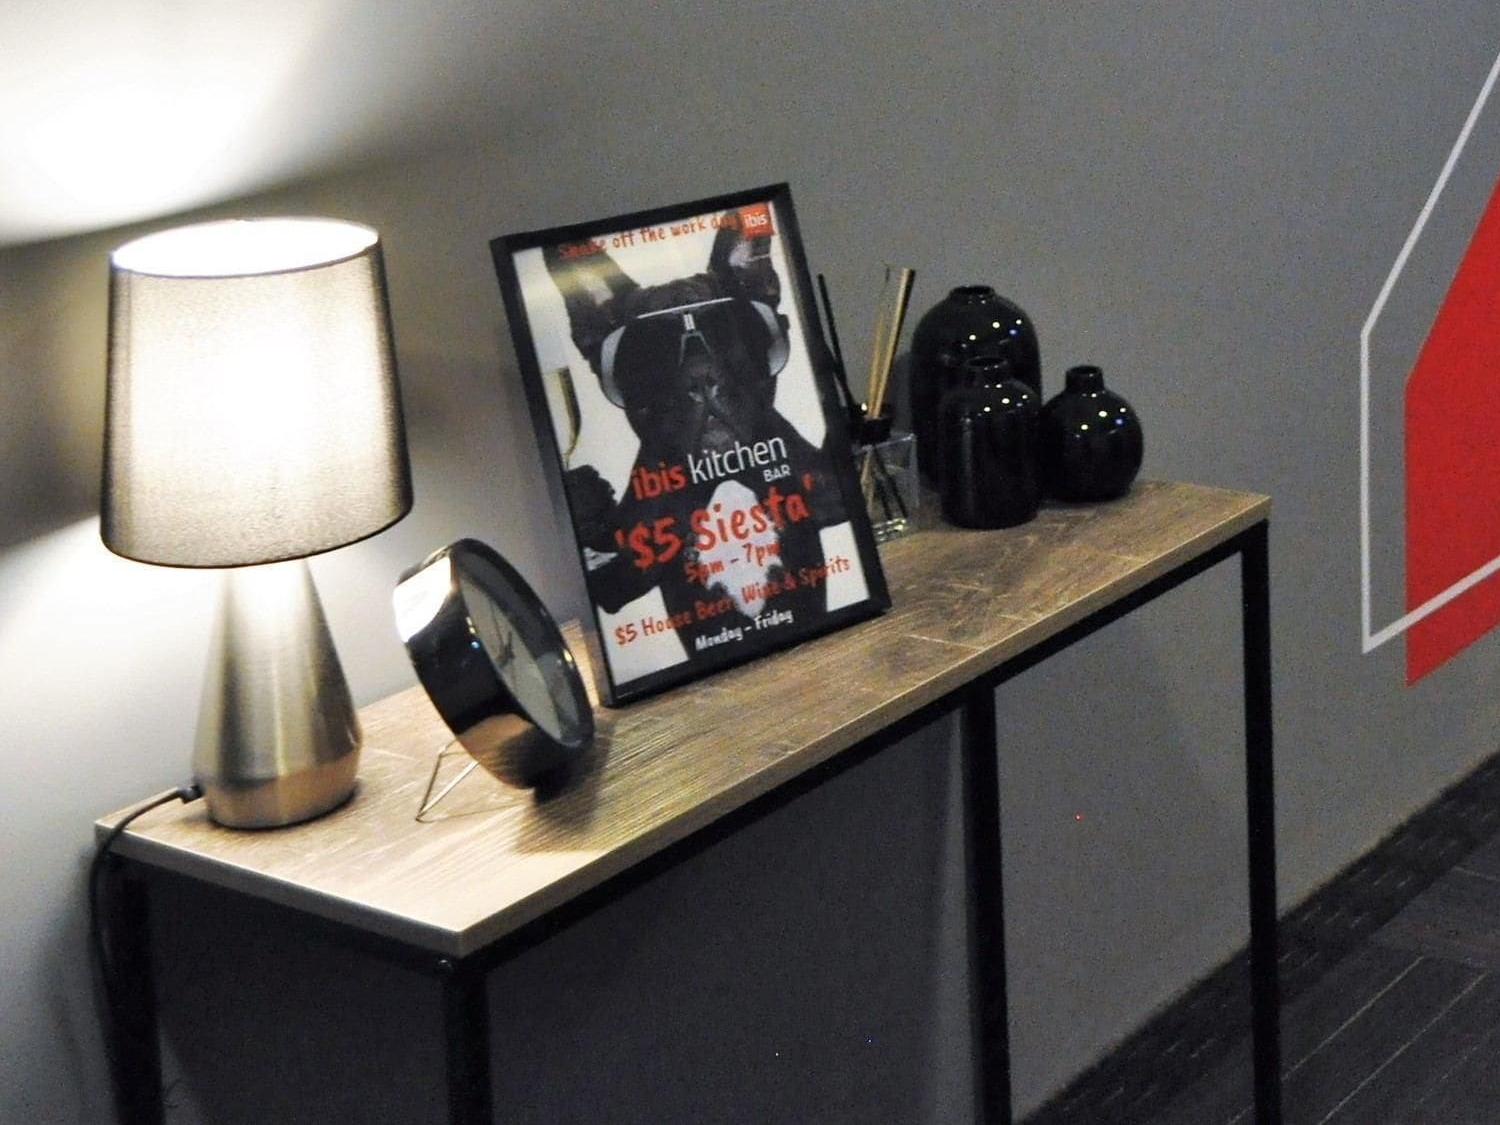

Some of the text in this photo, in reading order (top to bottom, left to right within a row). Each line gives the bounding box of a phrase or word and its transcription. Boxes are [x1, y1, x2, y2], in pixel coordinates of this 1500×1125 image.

[612, 231, 634, 248] off
[640, 226, 665, 244] the
[671, 216, 707, 236] work
[744, 211, 768, 228] ibis
[631, 437, 788, 501] ibis kitchen
[763, 464, 791, 482] BAR
[684, 558, 724, 583] 5pm
[742, 542, 780, 566] 7pm
[614, 624, 639, 647] $5
[641, 610, 692, 637] House
[741, 580, 782, 604] Wine
[783, 572, 797, 591] &
[798, 555, 851, 589] Spirits
[695, 625, 744, 651] Monday
[753, 608, 794, 632] Friday
